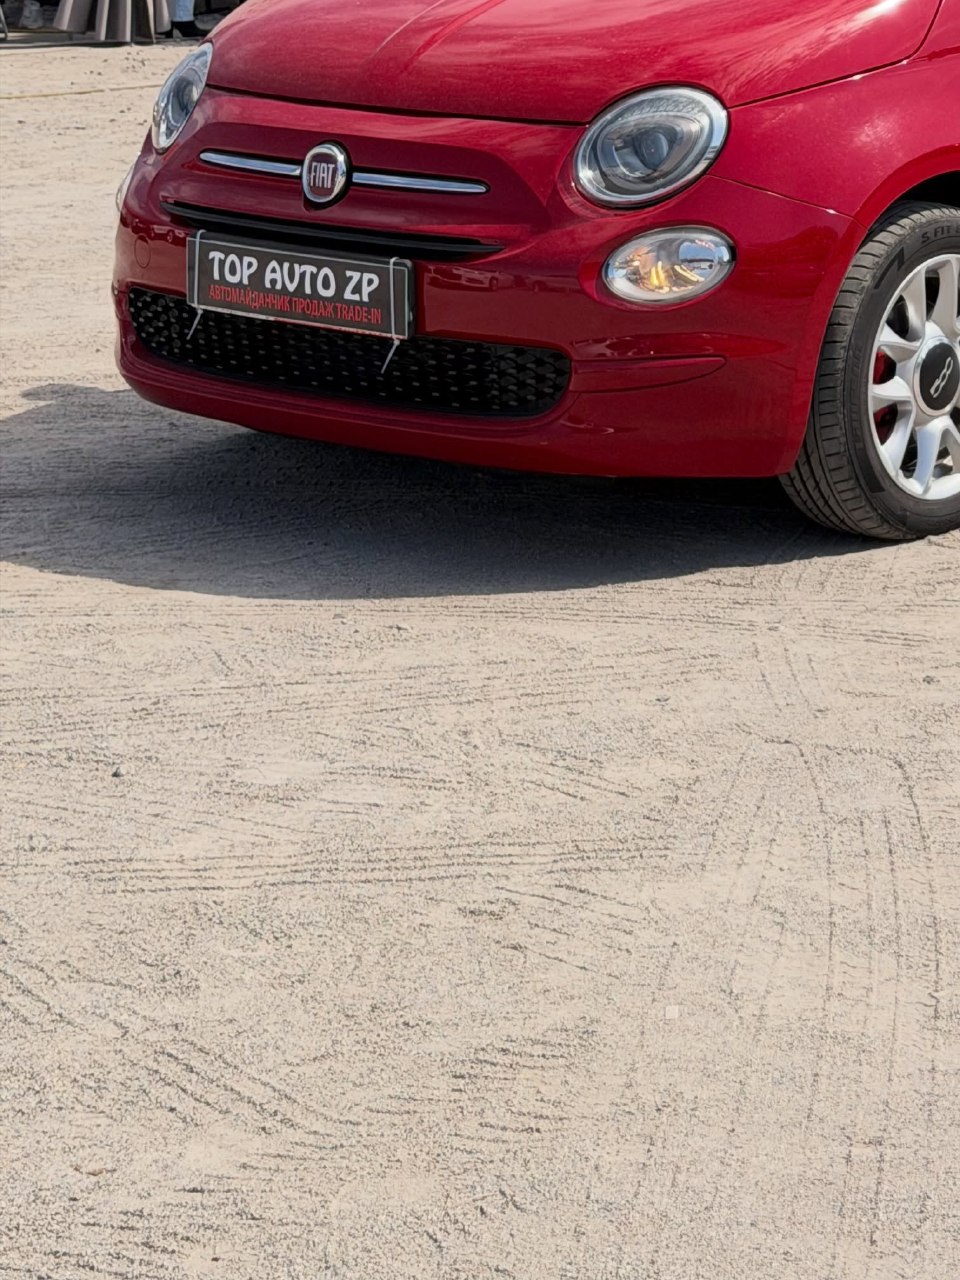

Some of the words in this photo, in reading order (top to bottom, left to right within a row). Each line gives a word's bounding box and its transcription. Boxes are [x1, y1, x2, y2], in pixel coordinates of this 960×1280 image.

[310, 161, 335, 189] FIAT
[934, 225, 952, 237] FIT
[208, 251, 258, 285] TOP
[343, 270, 380, 302] ZP
[208, 285, 290, 311] АВТОМАЙДАНЧИК
[292, 297, 335, 318] ПРОДАЖ
[336, 303, 382, 325] TRADE-IN
